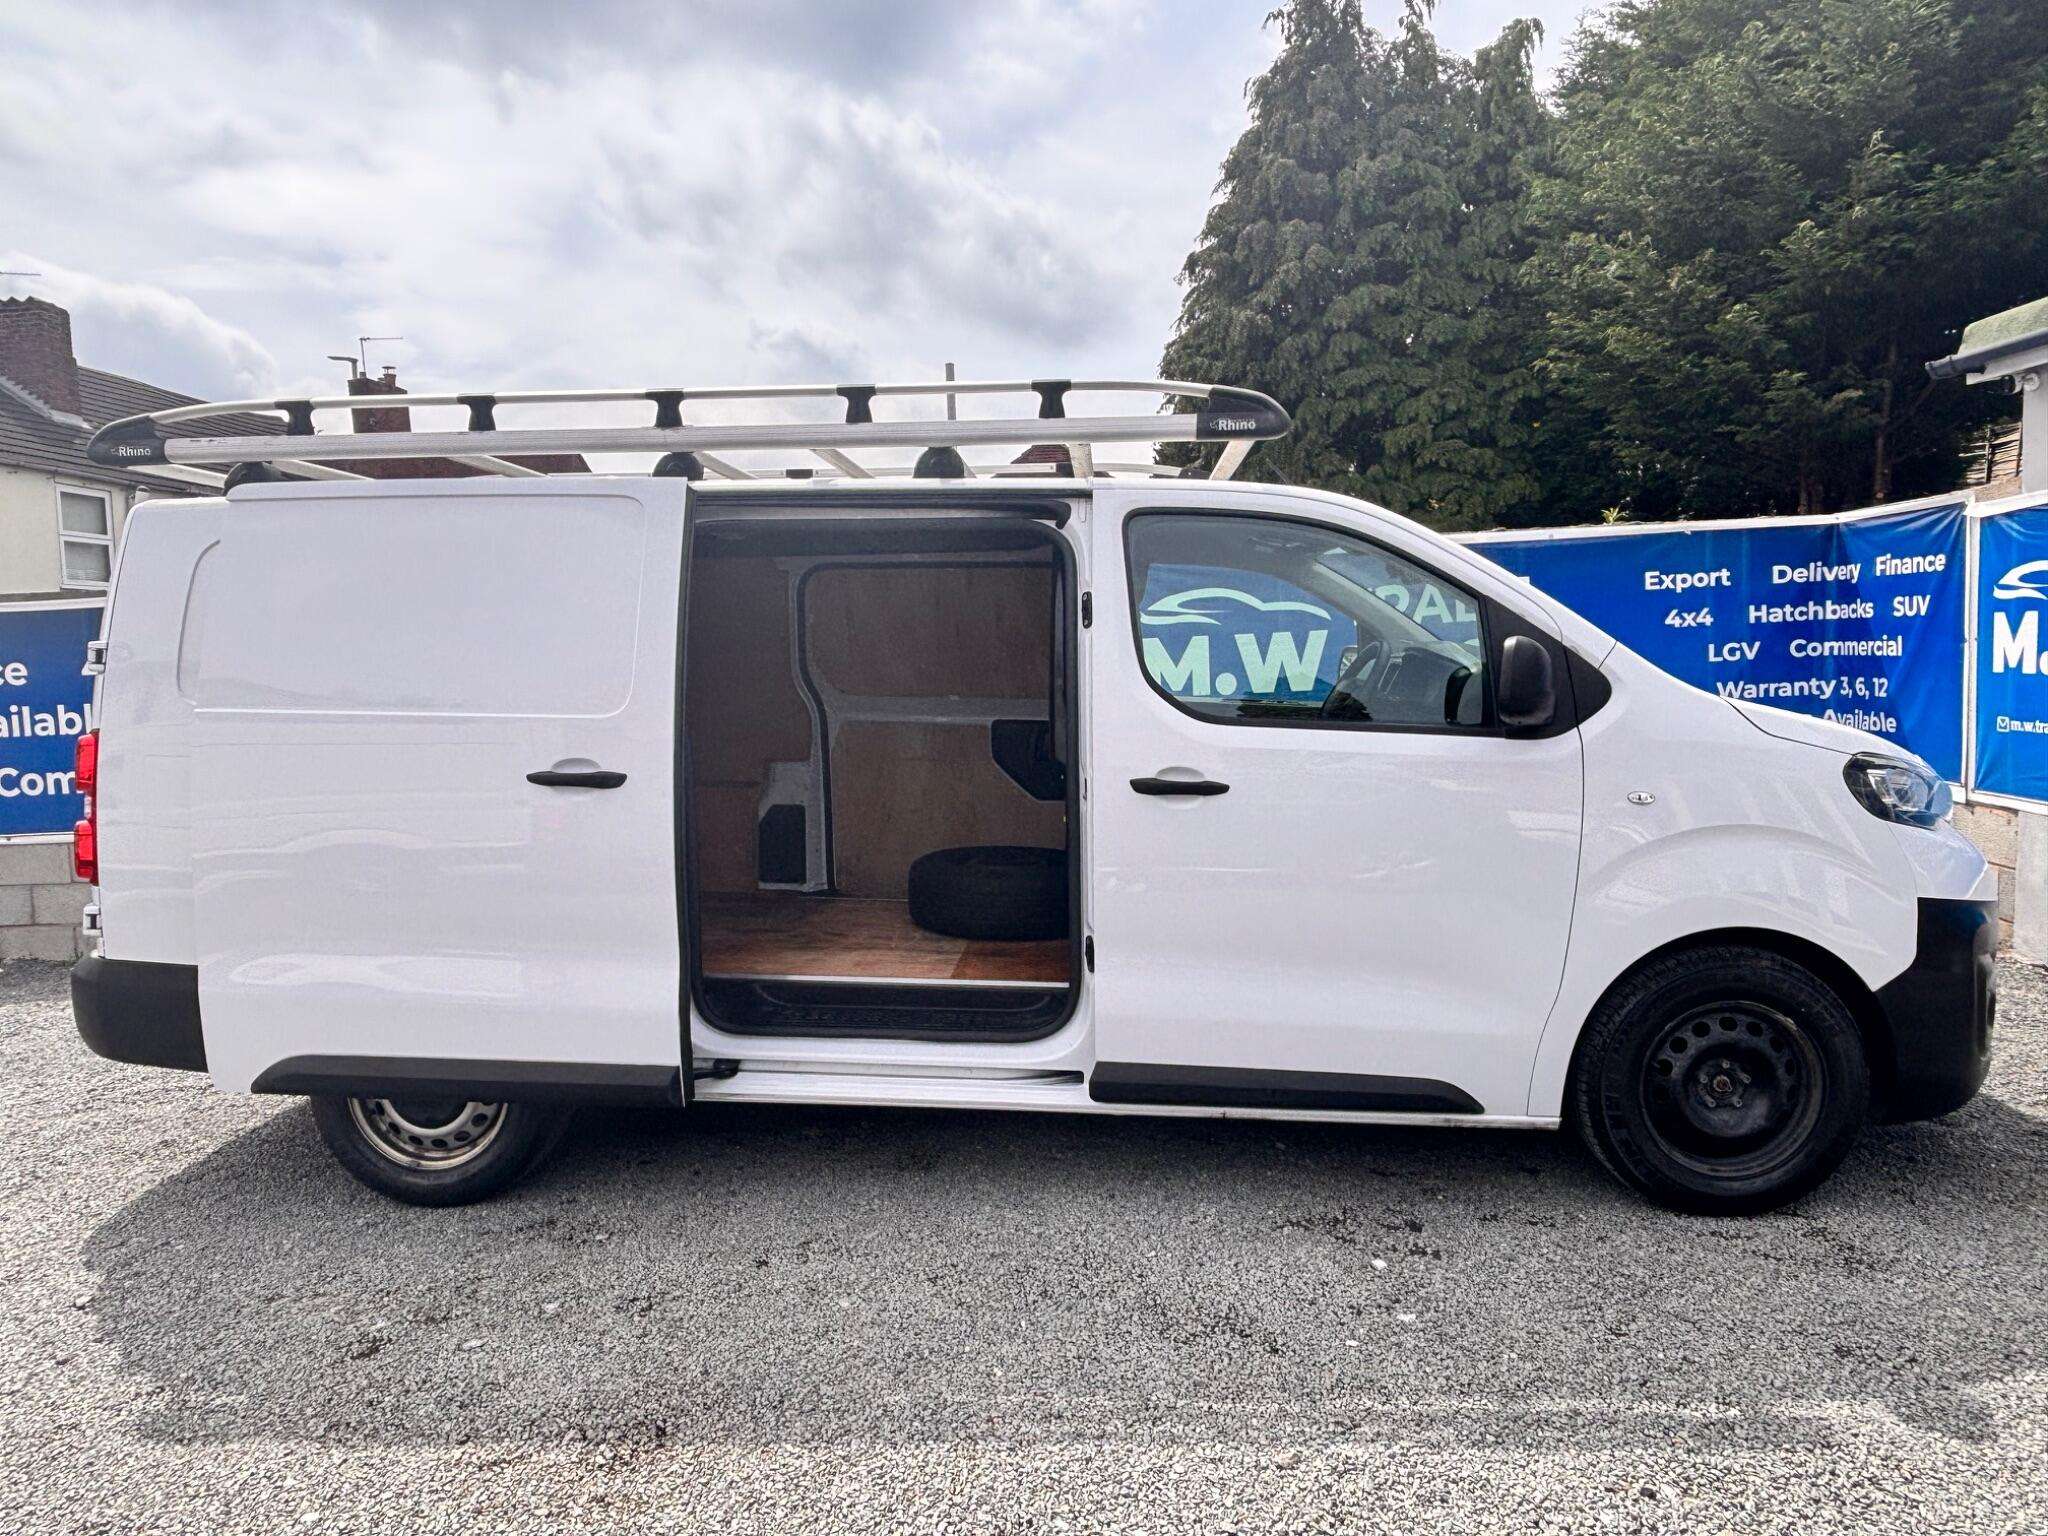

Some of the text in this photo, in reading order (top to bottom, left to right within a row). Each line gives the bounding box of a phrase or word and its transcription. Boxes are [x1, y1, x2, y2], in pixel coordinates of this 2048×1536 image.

[1218, 418, 1256, 431] Rhino
[118, 446, 151, 457] Rhino
[1644, 553, 1946, 593] Export Delivery Finance
[1664, 595, 1931, 628] 4x4 Hatchbacks SUV
[1707, 635, 1903, 662] LGV Commercial
[1142, 630, 1329, 697] M.W
[1716, 676, 1889, 700] Warranty 3, 6, 12
